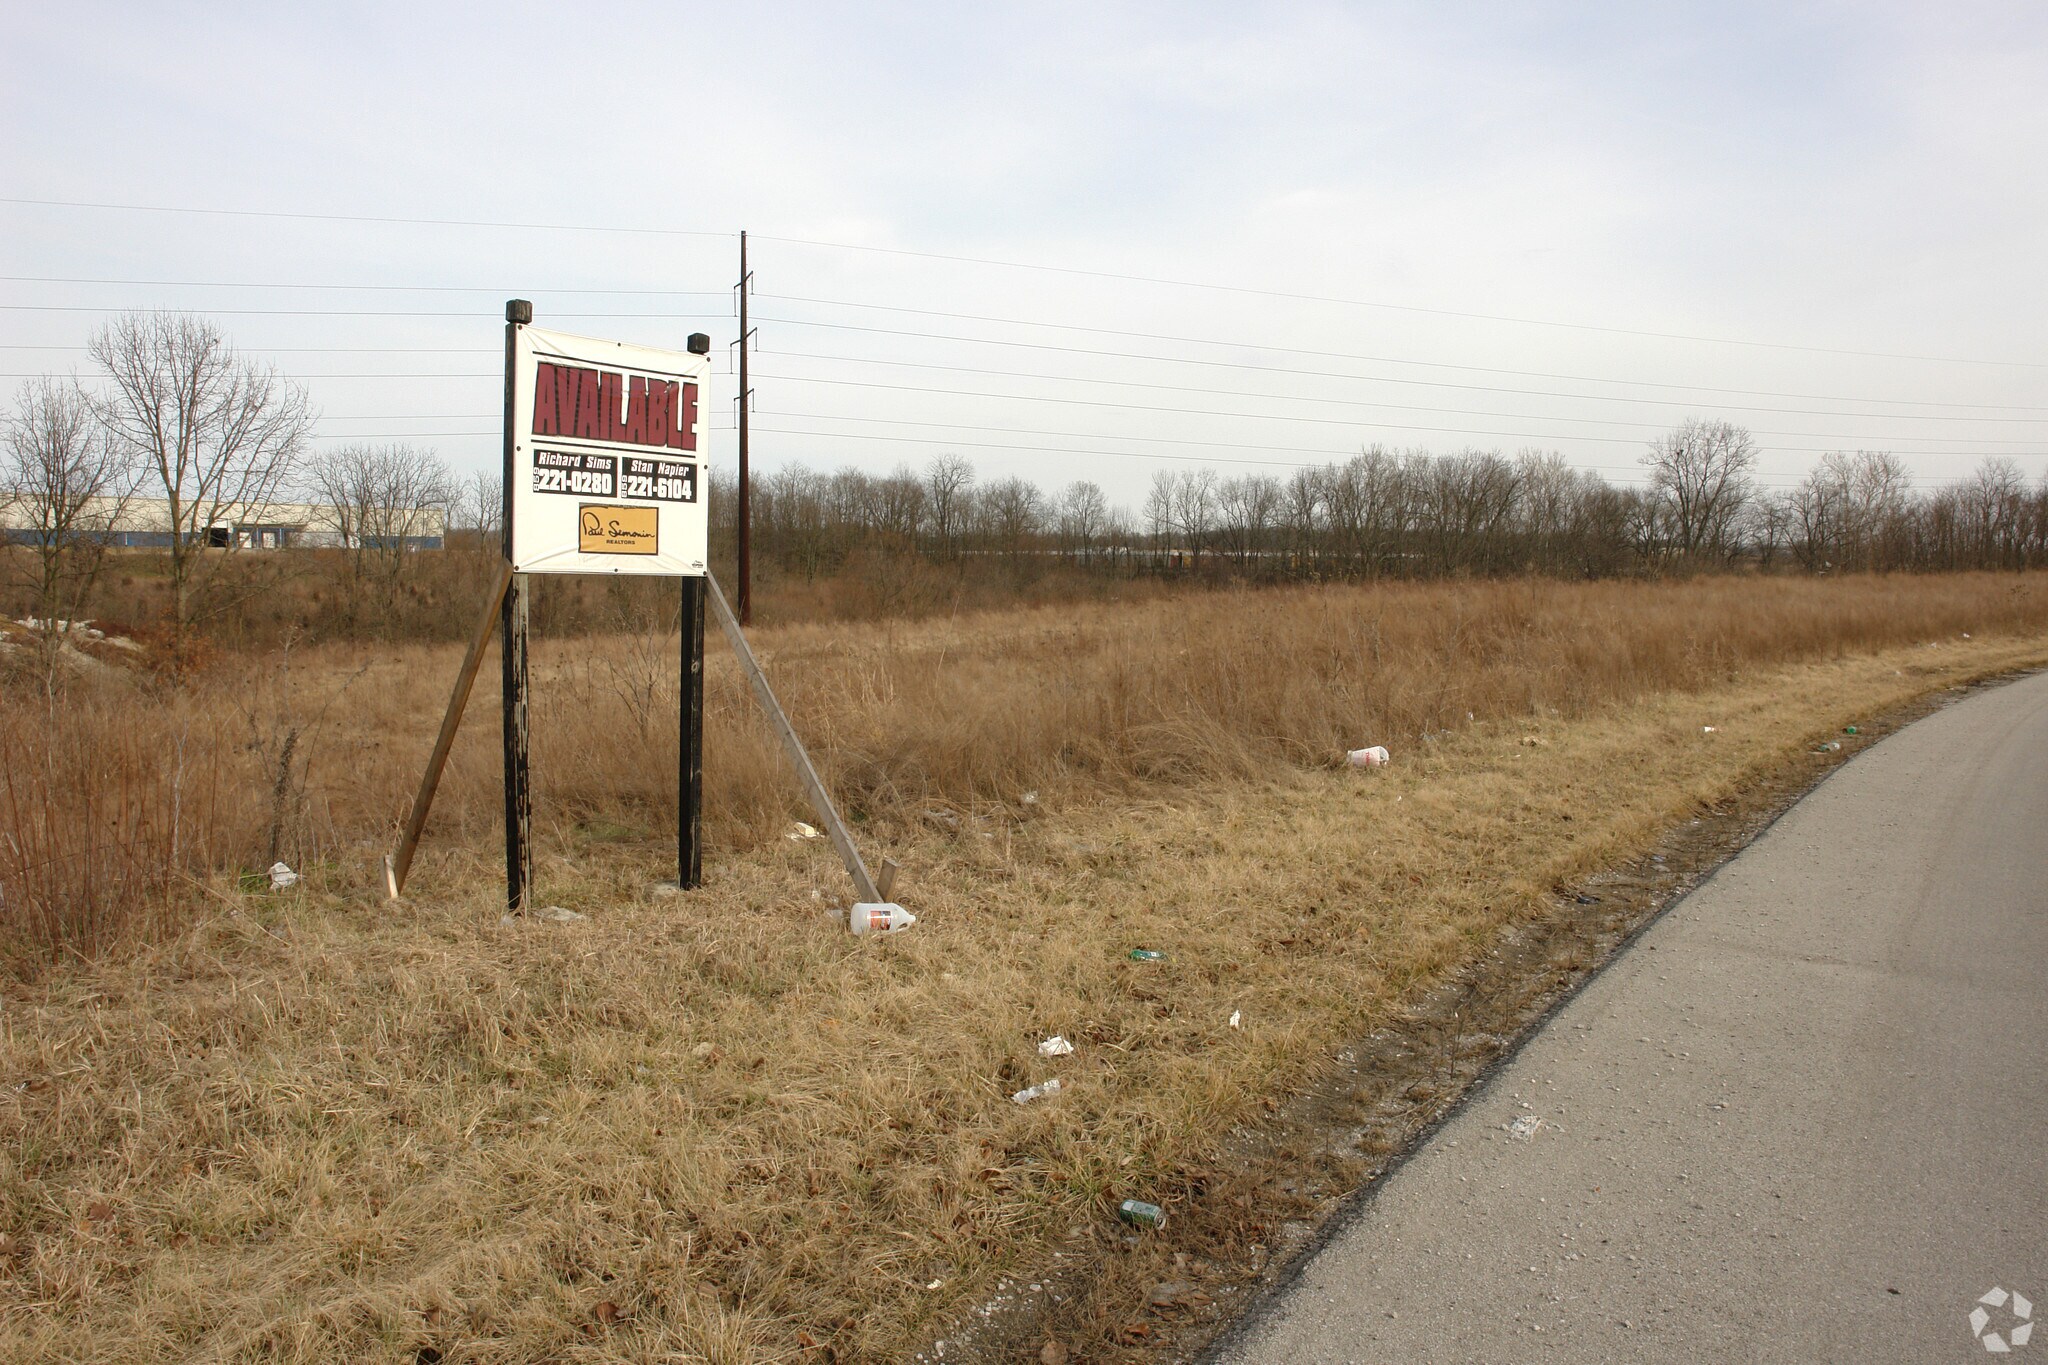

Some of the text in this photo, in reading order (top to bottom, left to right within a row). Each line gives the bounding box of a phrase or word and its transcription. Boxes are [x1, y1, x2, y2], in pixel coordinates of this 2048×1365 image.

[532, 360, 698, 451] AVAILABLE
[538, 452, 612, 469] Richard Sims
[631, 460, 689, 477] Stan Napier
[539, 468, 612, 494] 221-0280
[627, 476, 692, 500] 221-6104
[582, 512, 605, 536] Paul
